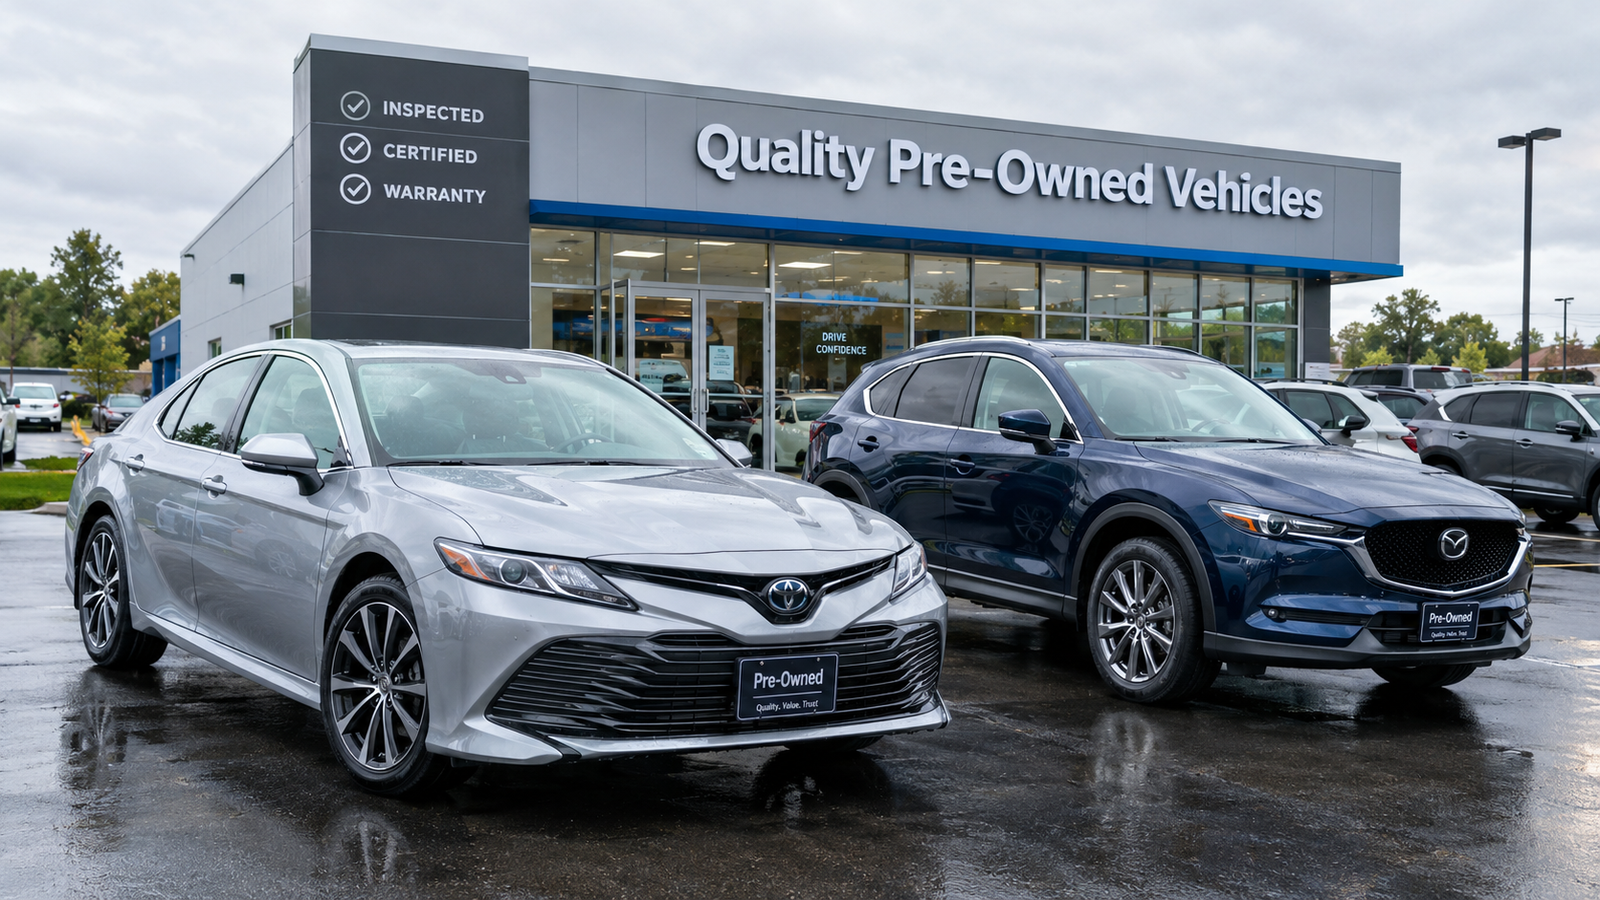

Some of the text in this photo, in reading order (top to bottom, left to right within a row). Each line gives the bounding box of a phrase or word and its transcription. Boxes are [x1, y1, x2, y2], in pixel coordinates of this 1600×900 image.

[383, 100, 485, 123] INSPECTED
[383, 143, 478, 164] CERTIFIED
[696, 123, 1324, 220] Quality Pre-Owned Vehicles
[383, 183, 486, 204] WARRANTY
[822, 332, 847, 342] DRIVE
[815, 344, 867, 355] CONFIDENCE
[1429, 611, 1472, 623] Pre-Owned
[753, 668, 823, 689] Pre-Owned
